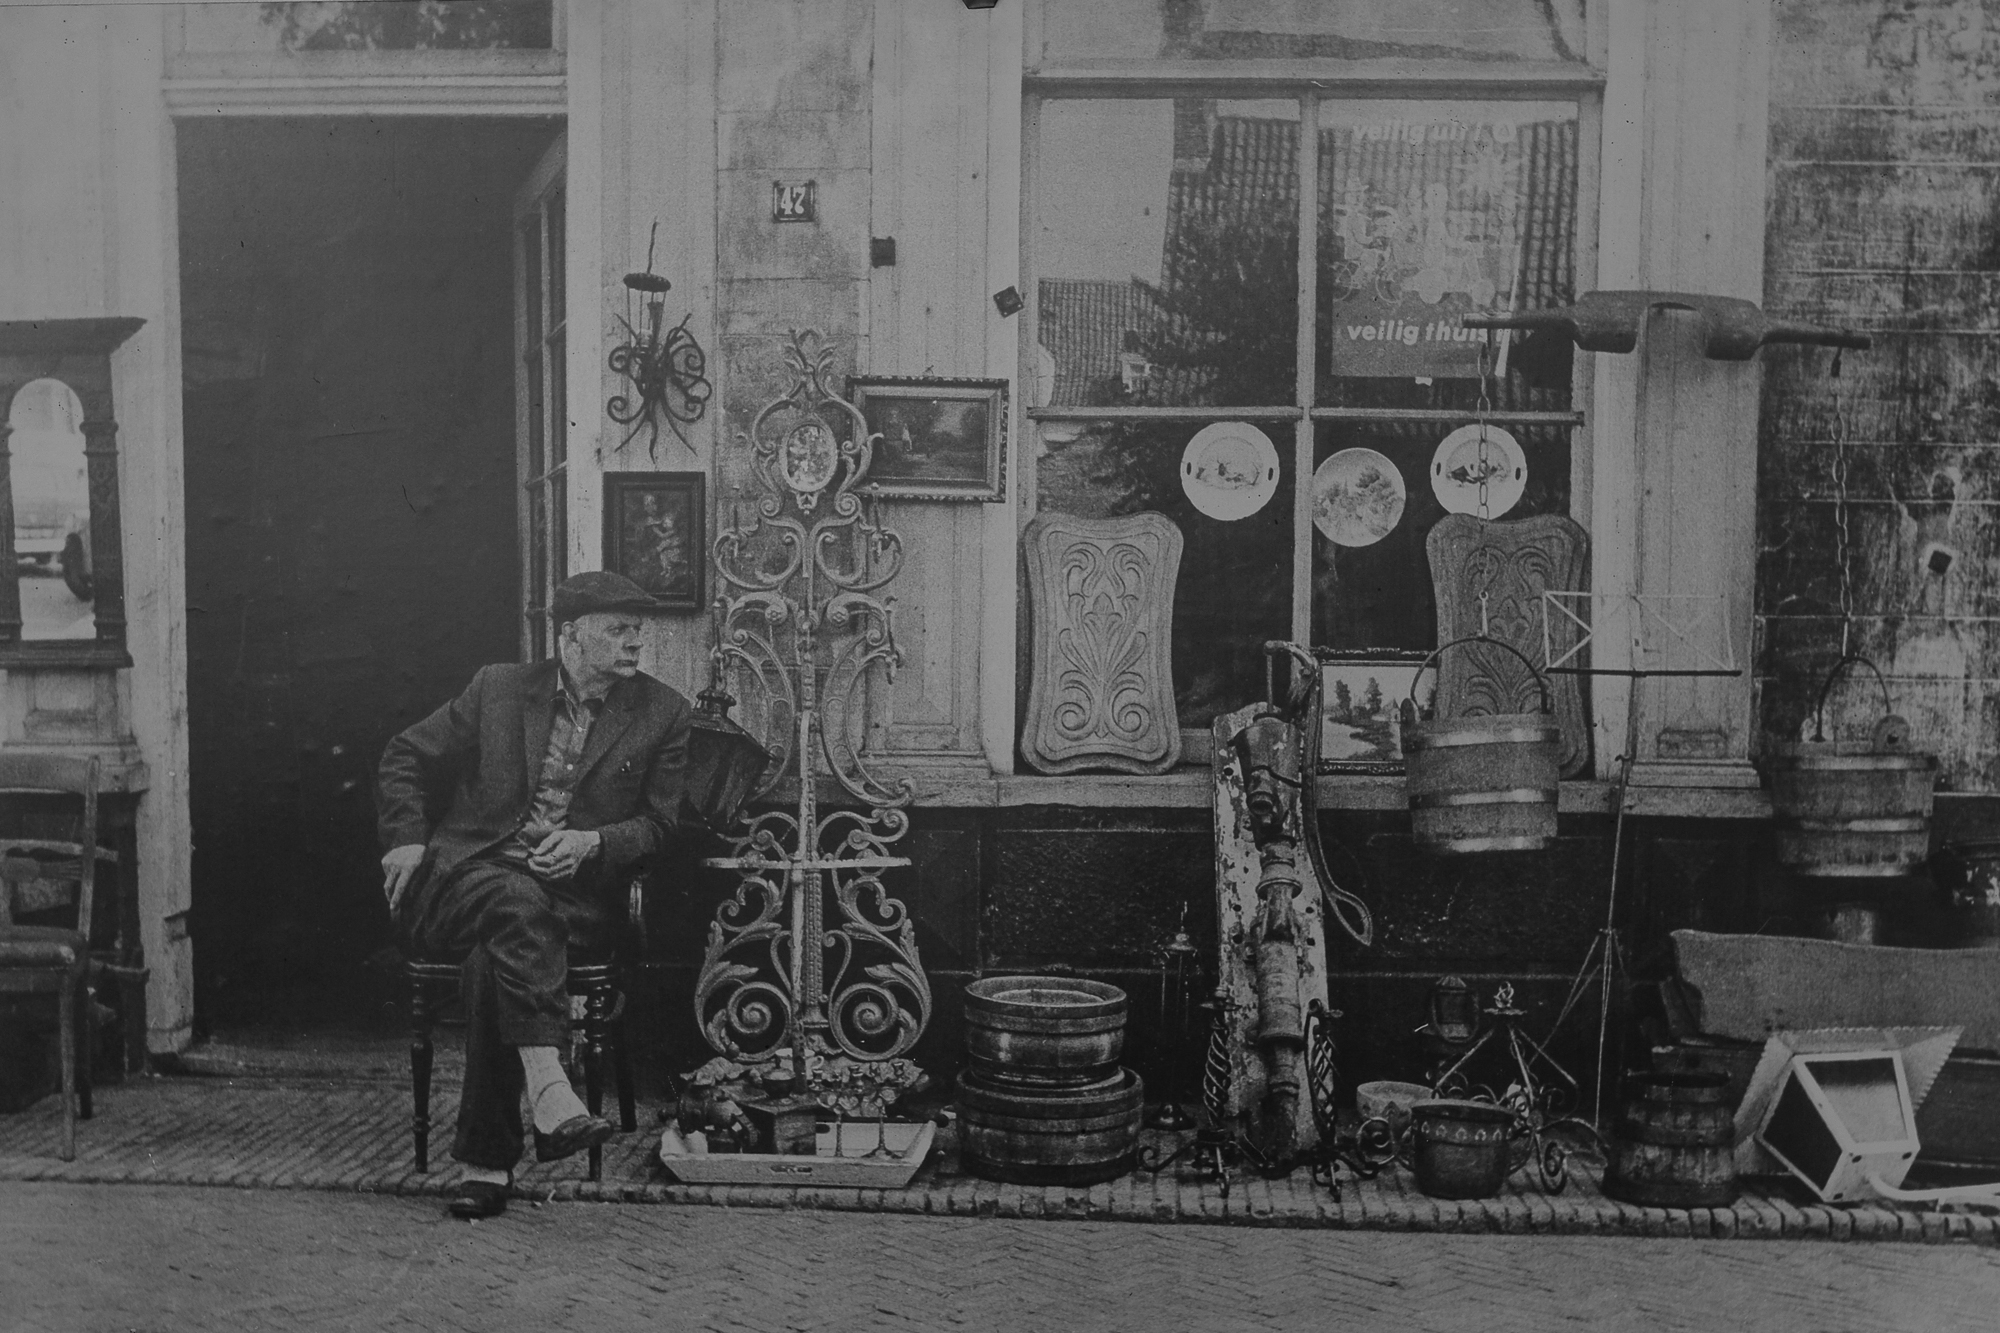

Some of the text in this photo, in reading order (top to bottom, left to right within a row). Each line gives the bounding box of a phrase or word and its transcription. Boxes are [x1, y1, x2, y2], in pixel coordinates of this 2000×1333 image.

[1352, 119, 1426, 145] veilig
[781, 187, 806, 214] 47
[1347, 320, 1420, 345] veilig
